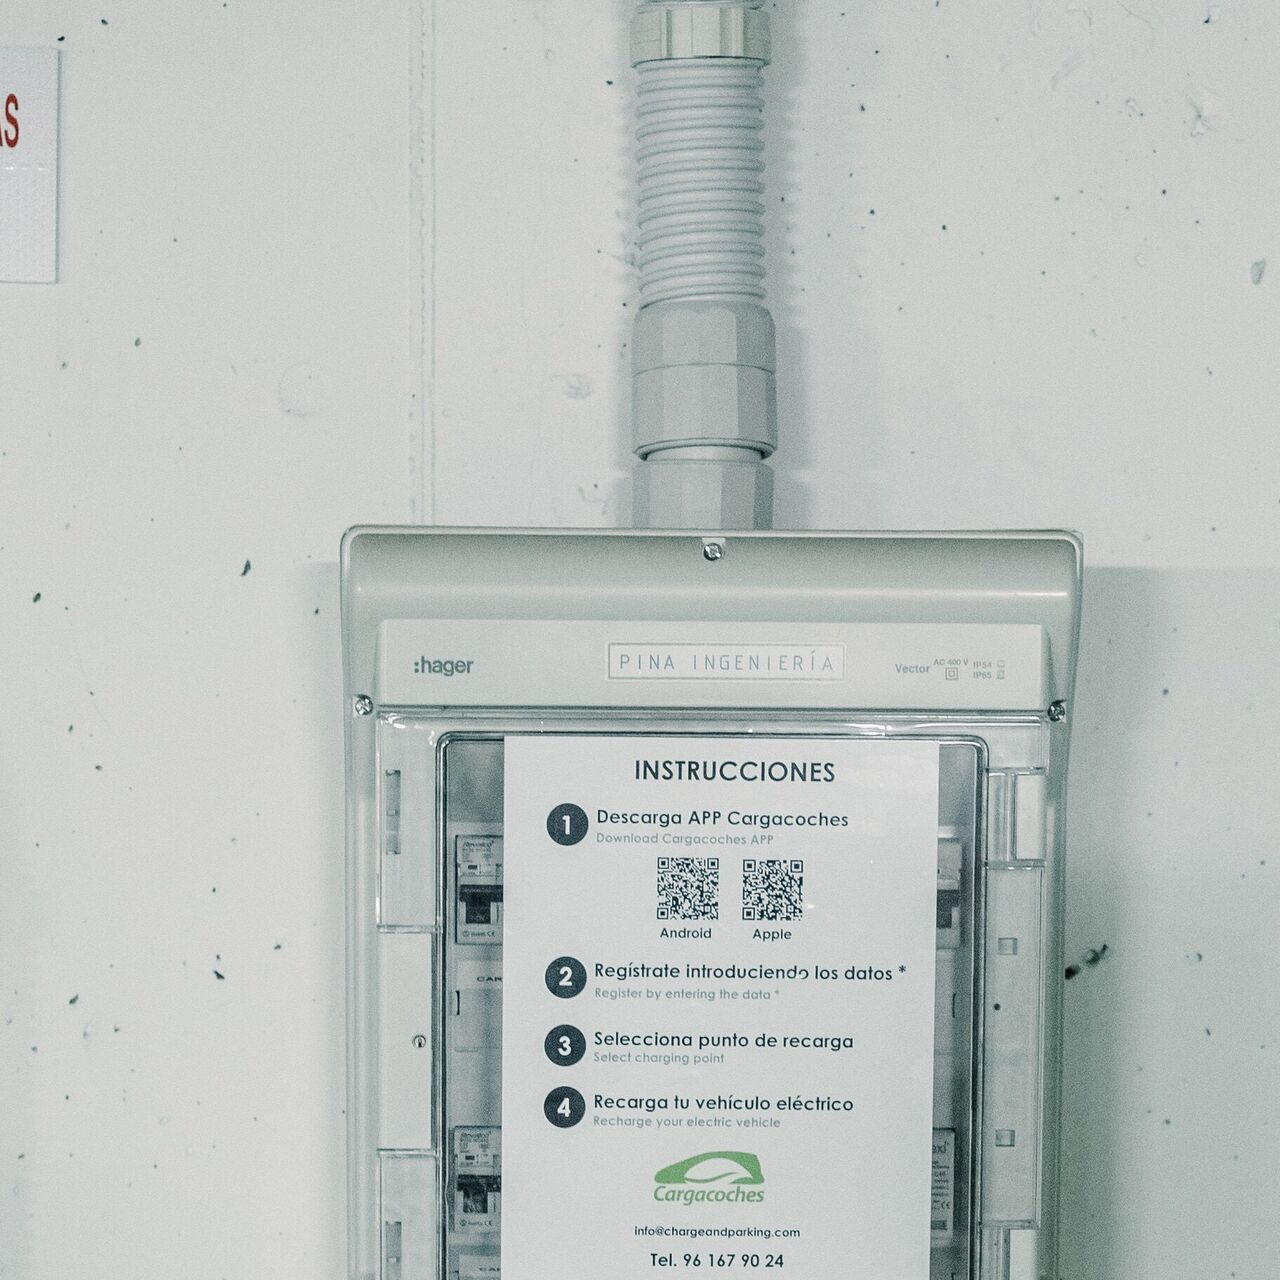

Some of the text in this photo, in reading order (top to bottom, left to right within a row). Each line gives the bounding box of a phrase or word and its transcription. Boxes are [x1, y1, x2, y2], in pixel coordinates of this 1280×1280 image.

[620, 650, 833, 671] PINA INGENIERÍA
[895, 664, 930, 674] Vector
[636, 760, 835, 782] INSTRUCCIONES
[561, 815, 572, 836] 1
[597, 809, 848, 829] Descarga APP Cargacoches
[596, 832, 774, 846] Download Cargacoches APP
[660, 928, 793, 943] Android Apple
[558, 966, 573, 987] 2
[595, 962, 680, 981] Regístrate
[686, 964, 809, 979] introduciendo
[815, 966, 838, 980] los
[844, 966, 892, 980] datos
[594, 987, 643, 1001] Register
[646, 988, 661, 1000] by
[665, 989, 715, 1002] entering
[719, 989, 739, 1000] the
[744, 990, 771, 1000] data
[558, 1036, 571, 1056] 3
[594, 1031, 853, 1051] Selecciona punto de recarga
[594, 1051, 725, 1066] Select charging point
[557, 1097, 571, 1117] 4
[594, 1094, 853, 1112] Recarga tu vehículo eléctrico
[593, 1115, 780, 1130] Recharge your electric vehicle
[653, 1185, 765, 1206] Cargacoches
[634, 1226, 800, 1239] info@chargeandparking.com
[650, 1252, 783, 1268] Tel. 96 167 90 24
